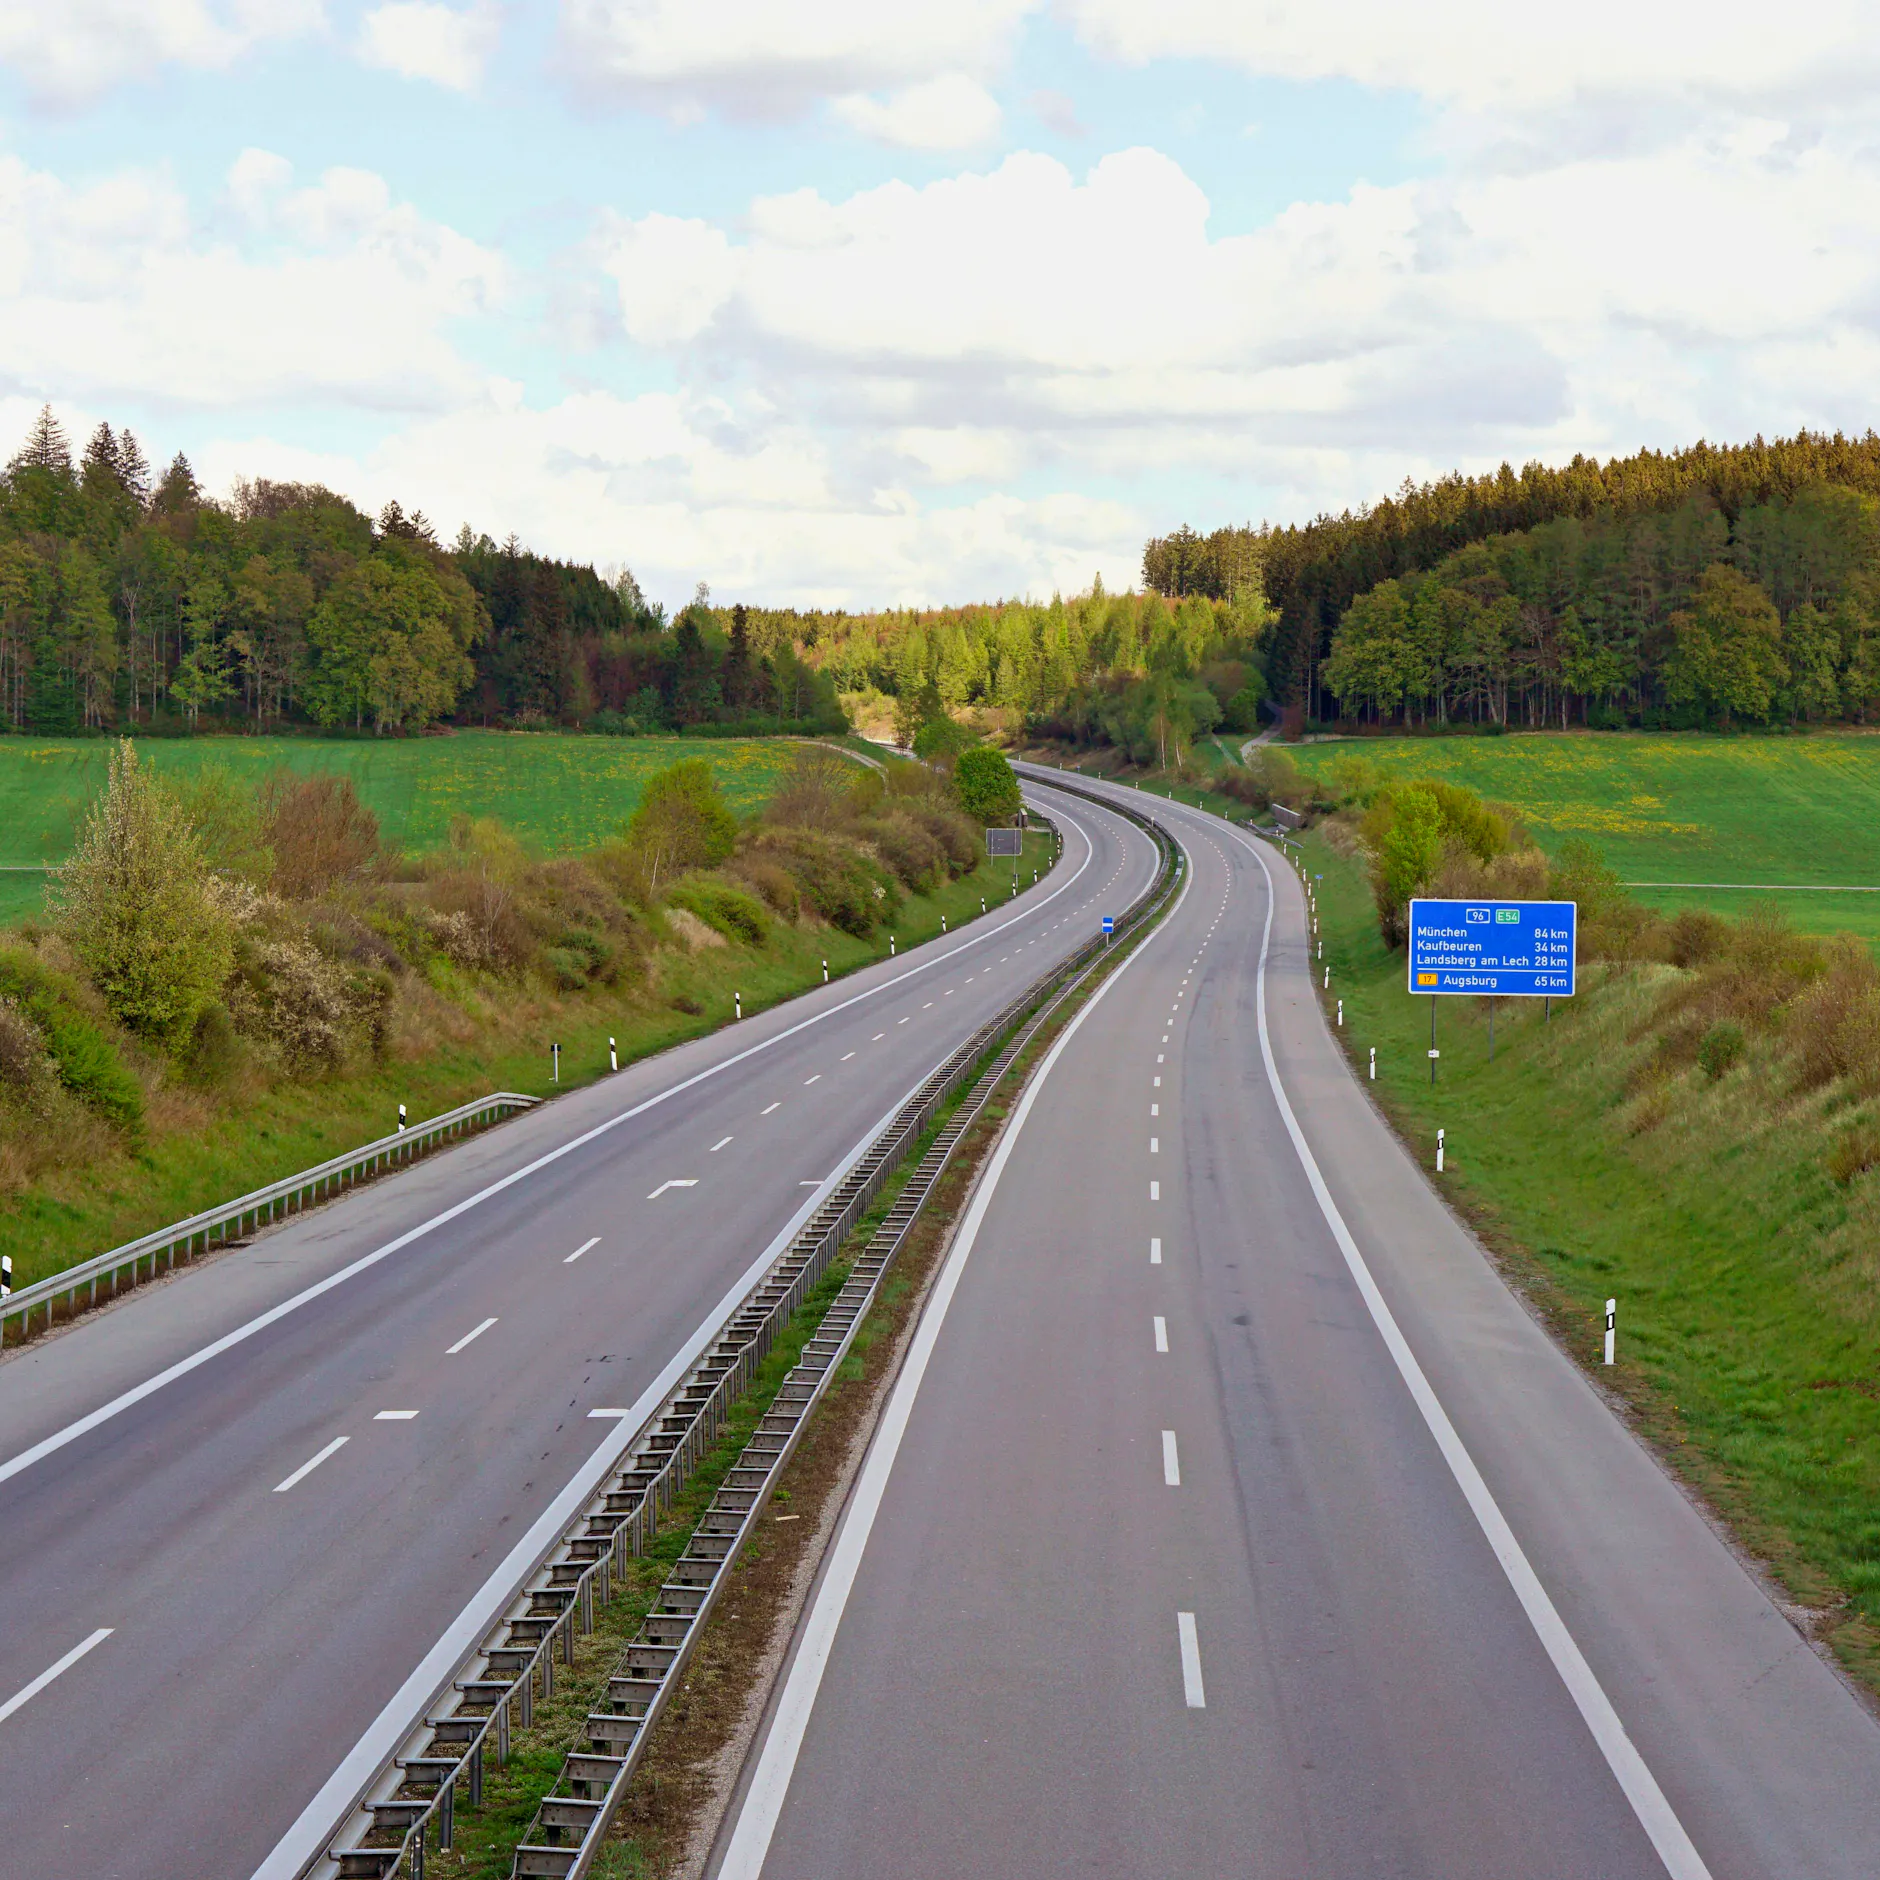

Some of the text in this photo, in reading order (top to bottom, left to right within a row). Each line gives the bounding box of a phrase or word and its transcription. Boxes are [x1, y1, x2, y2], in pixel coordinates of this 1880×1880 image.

[1472, 911, 1484, 921] 96
[1417, 926, 1568, 939] München 84 km
[1417, 940, 1568, 953] Kaufbeuren 34 km
[1417, 954, 1568, 967] Landsberg am Lech 28 km
[1443, 975, 1497, 988] Augsburg
[1534, 976, 1548, 986] 65
[1550, 976, 1567, 987] km
